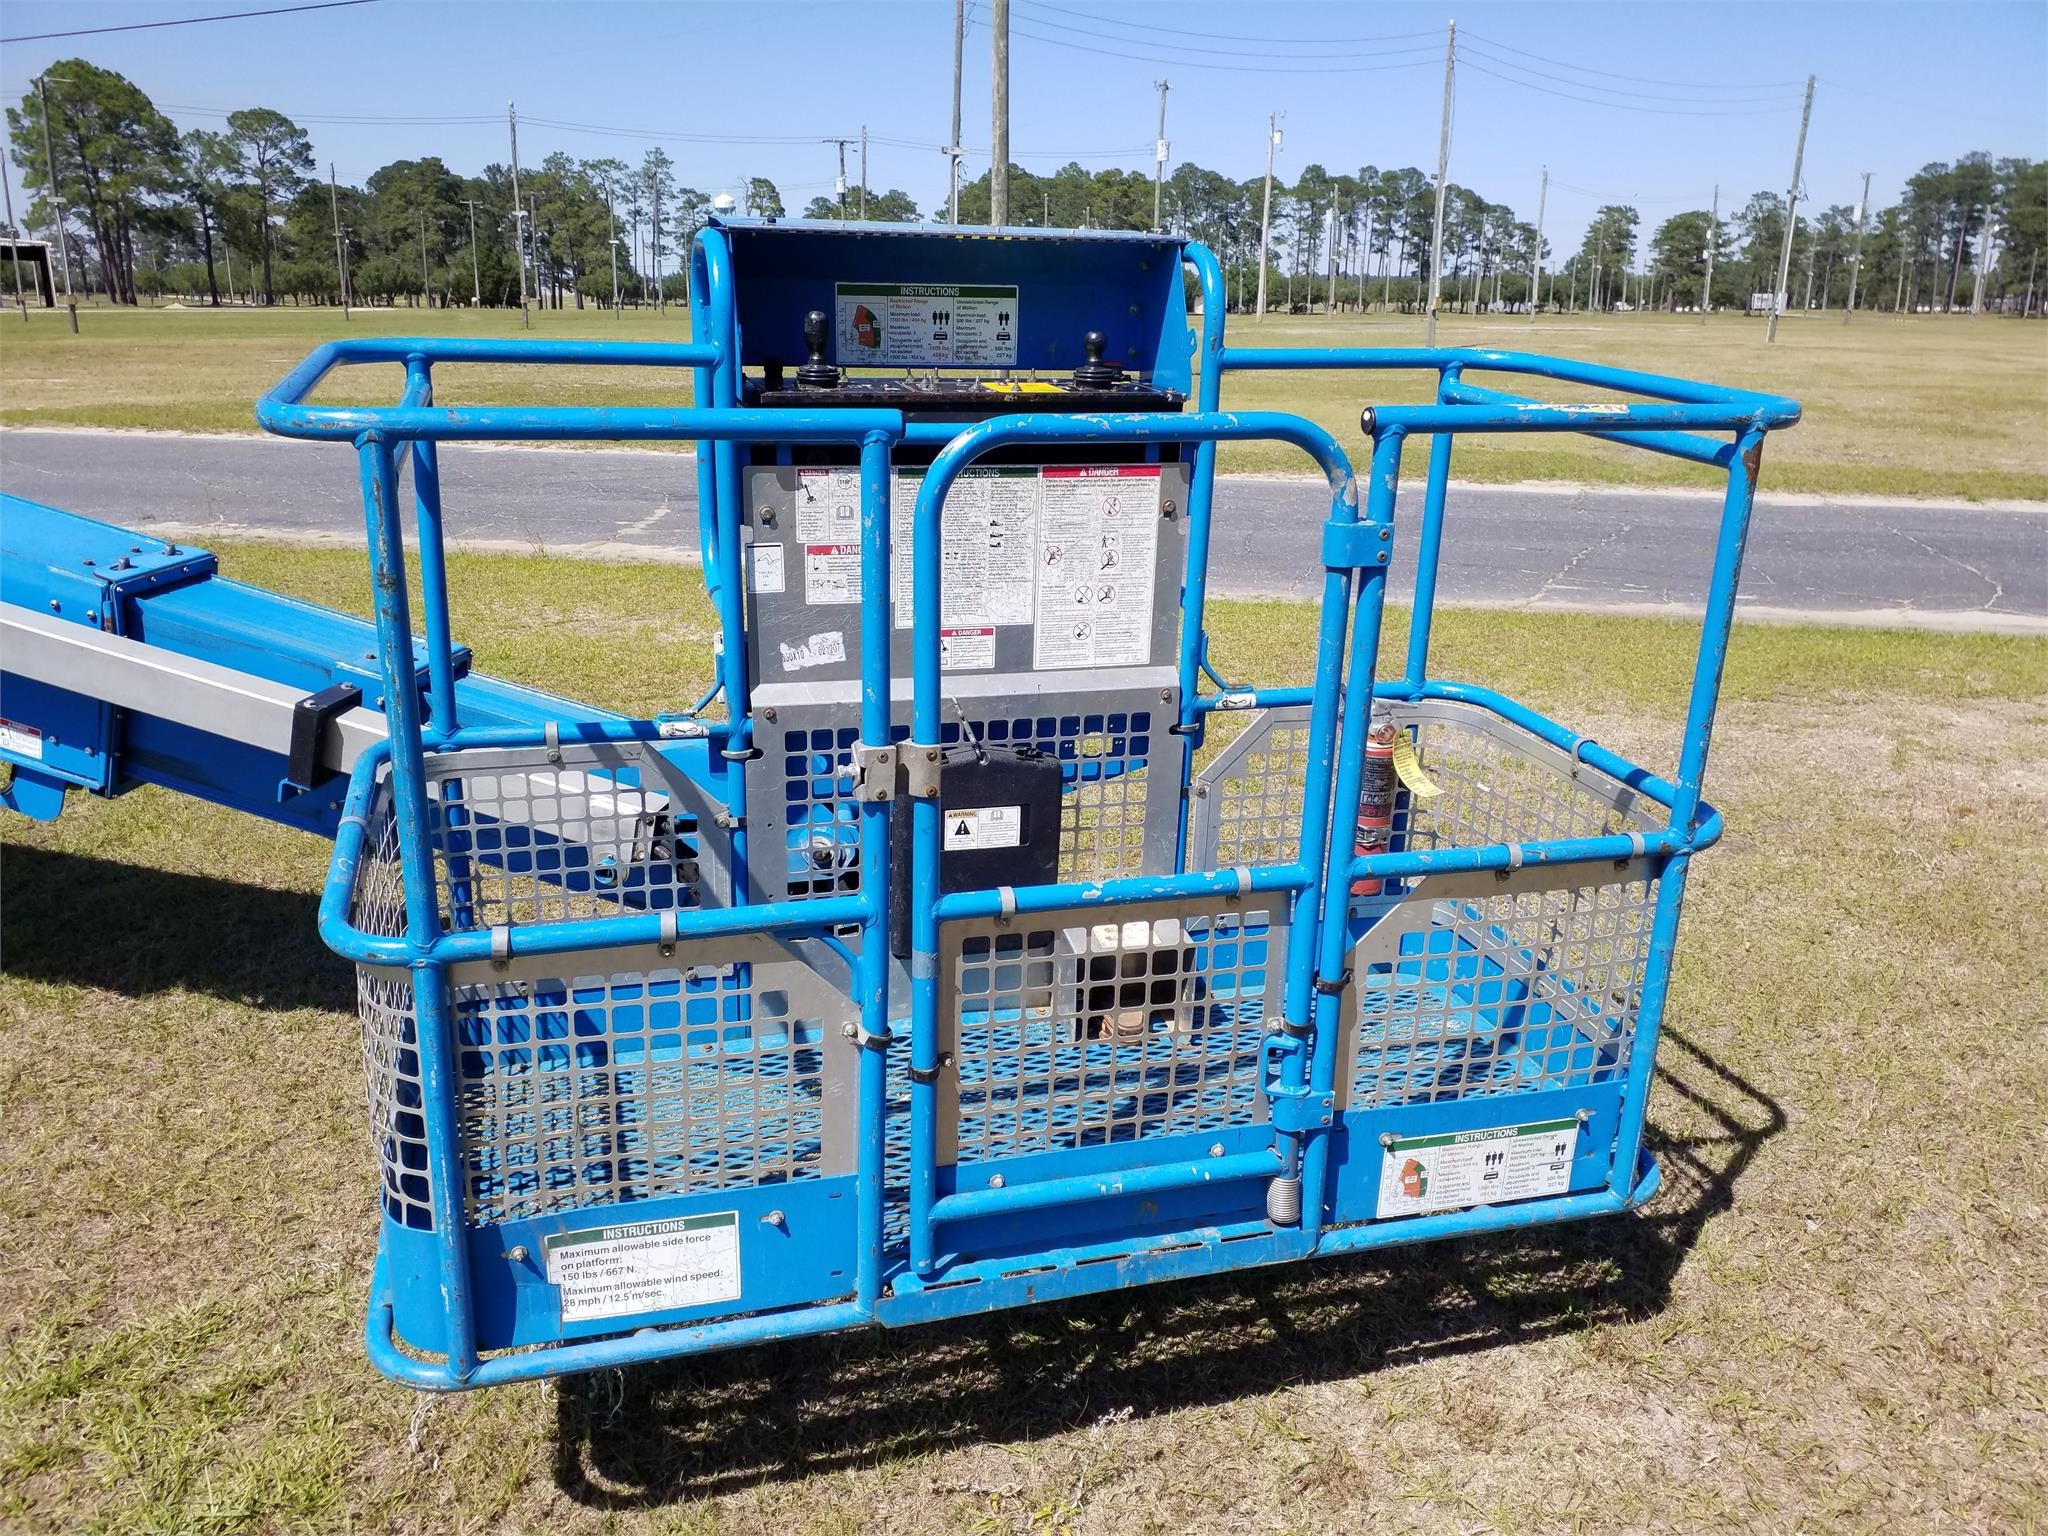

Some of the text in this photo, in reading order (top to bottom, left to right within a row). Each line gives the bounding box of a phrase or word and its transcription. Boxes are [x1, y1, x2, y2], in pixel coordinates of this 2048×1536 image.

[900, 287, 959, 296] INSTRUCTIONS
[1088, 468, 1118, 476] DANGER
[1454, 1128, 1518, 1143] INSTRUCTIONS
[603, 1220, 685, 1239] INSTRUCTIONS
[560, 1234, 711, 1260] Maximum allowable side force
[561, 1257, 623, 1271] on platform:
[562, 1272, 580, 1281] 150
[582, 1269, 598, 1279] lbs
[600, 1268, 604, 1277] /
[606, 1267, 624, 1276] 667
[563, 1269, 724, 1296] Maximum allowable wind speed:
[564, 1288, 665, 1308] 28 mph / 12.5 m/sec.
